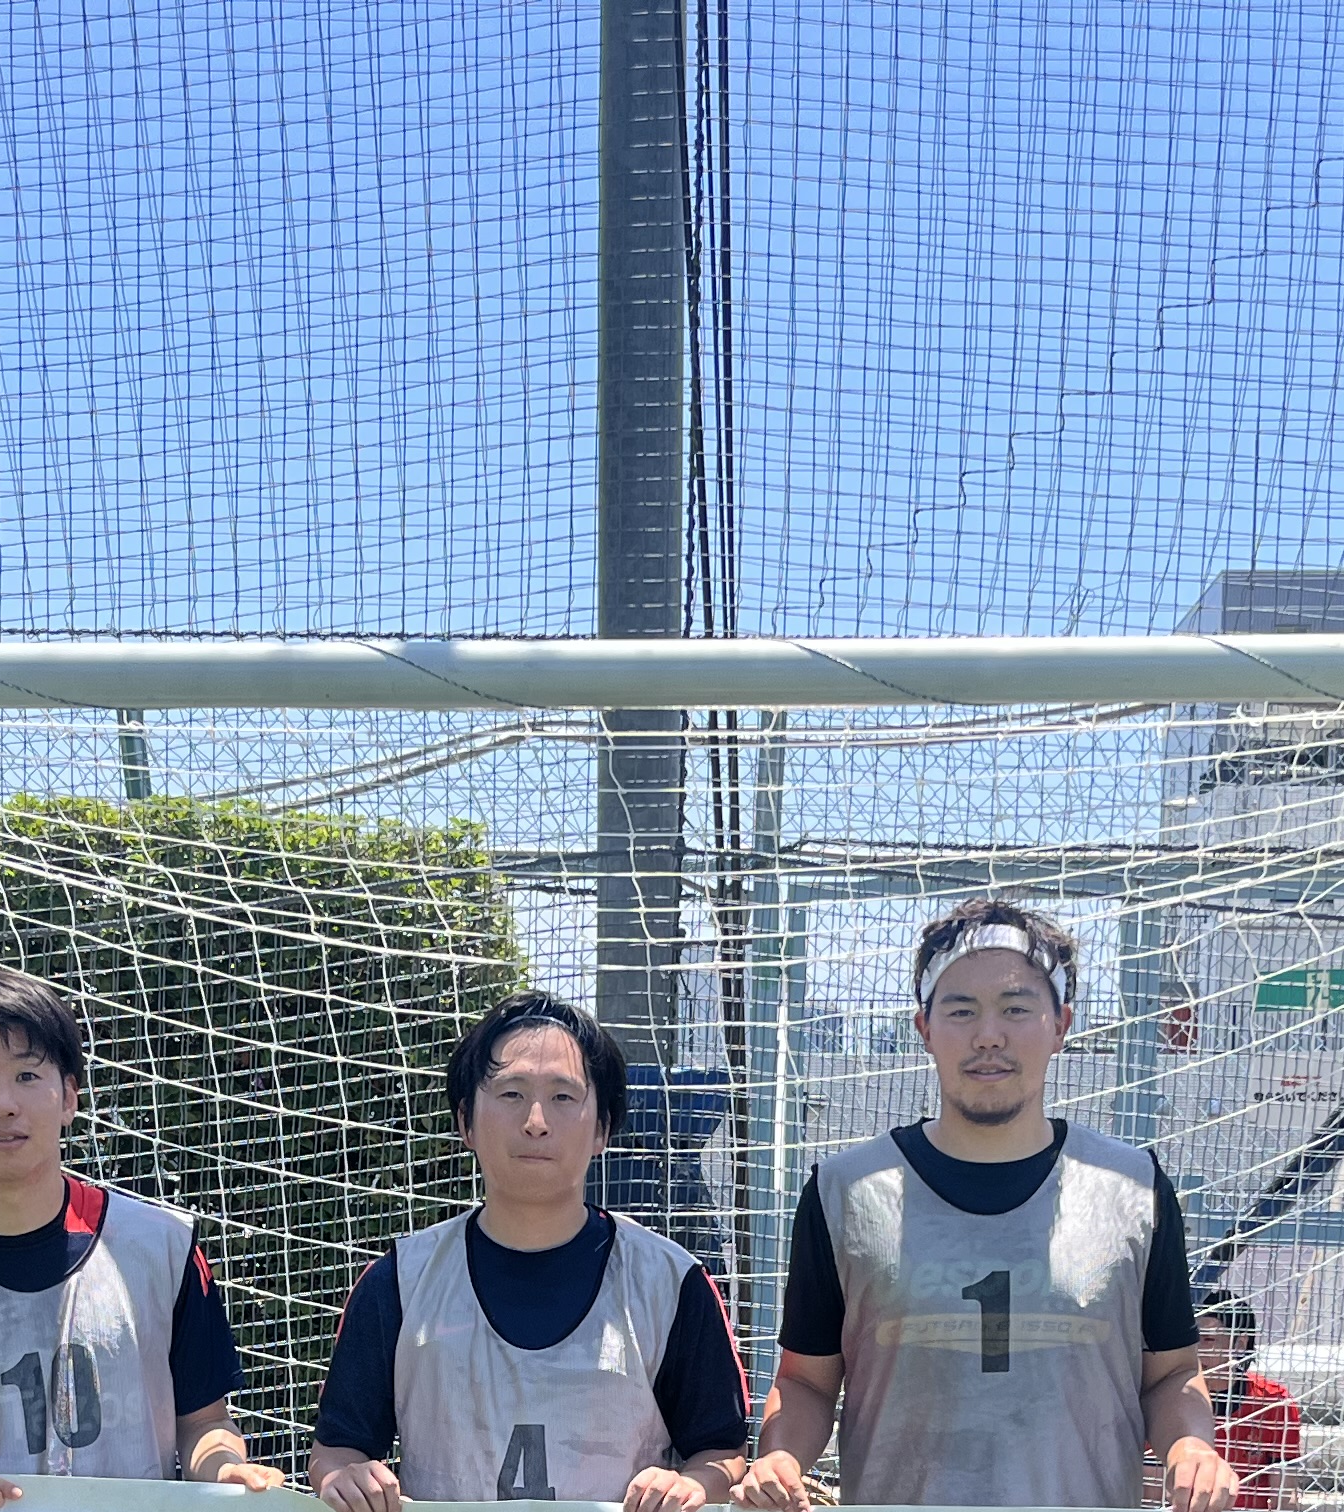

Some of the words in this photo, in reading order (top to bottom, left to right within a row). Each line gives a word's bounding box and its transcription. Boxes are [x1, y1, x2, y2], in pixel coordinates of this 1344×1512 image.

[961, 1270, 1010, 1373] 1
[0, 1343, 102, 1454] 10
[497, 1424, 556, 1501] 4
